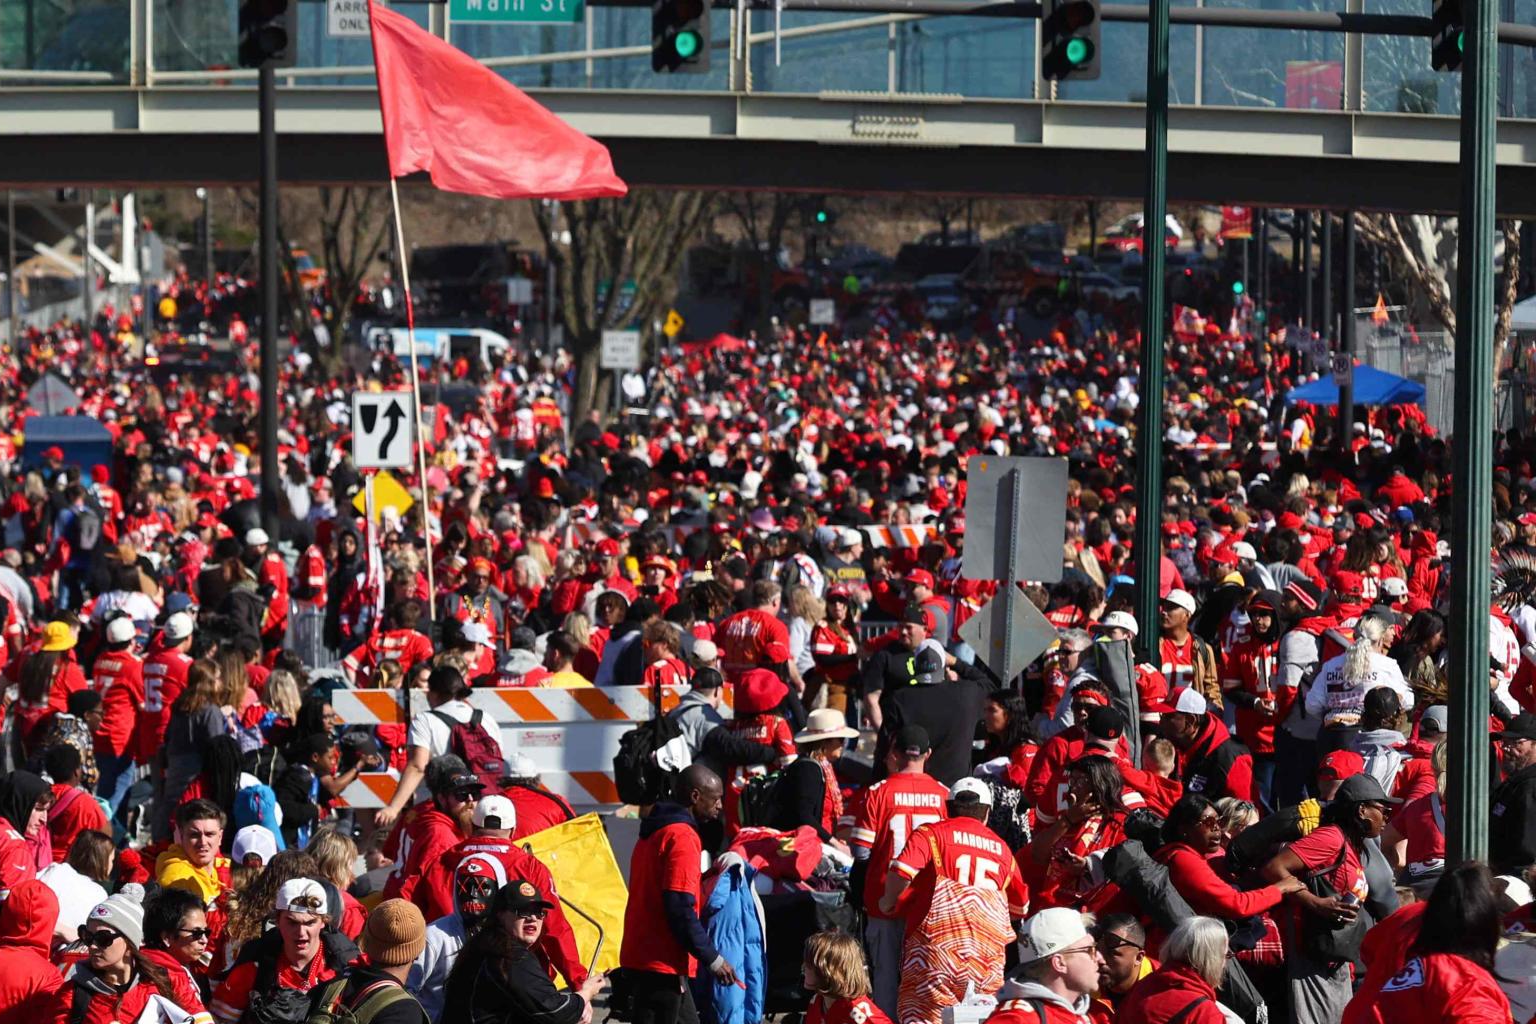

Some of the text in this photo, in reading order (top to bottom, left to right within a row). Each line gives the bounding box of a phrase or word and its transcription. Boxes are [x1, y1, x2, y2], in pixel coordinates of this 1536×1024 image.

[894, 792, 941, 808] MAHOMES
[953, 831, 1002, 856] MAHOMES
[955, 852, 1001, 892] 15
[850, 1001, 874, 1024] 87
